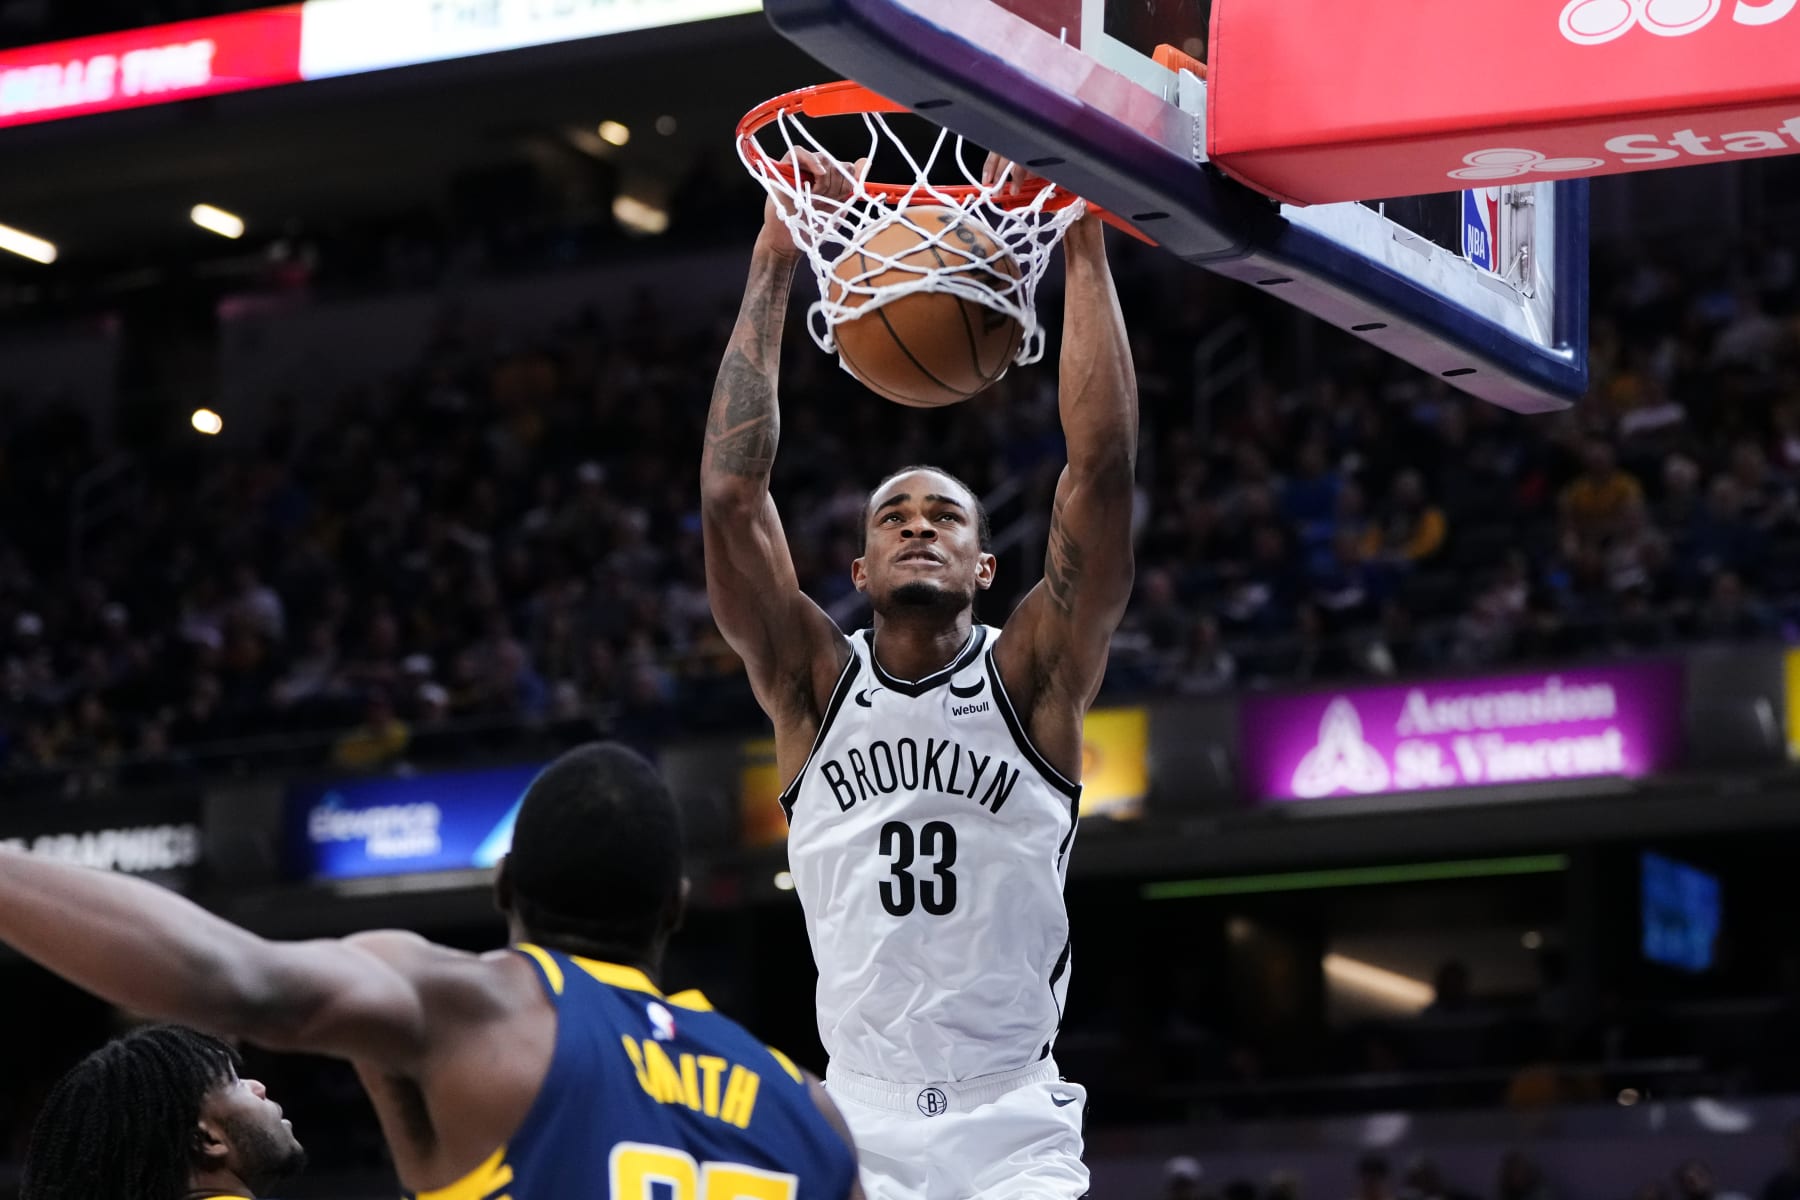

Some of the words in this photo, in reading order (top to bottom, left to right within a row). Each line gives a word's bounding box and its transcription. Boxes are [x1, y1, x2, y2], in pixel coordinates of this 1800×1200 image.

[1467, 223, 1486, 261] NBA
[952, 701, 990, 717] Webull
[1396, 676, 1617, 736] Ascension
[820, 737, 1021, 815] BROOKLYN
[1454, 728, 1624, 783] Vincent
[878, 821, 957, 917] 33
[621, 1034, 760, 1130] SMITH
